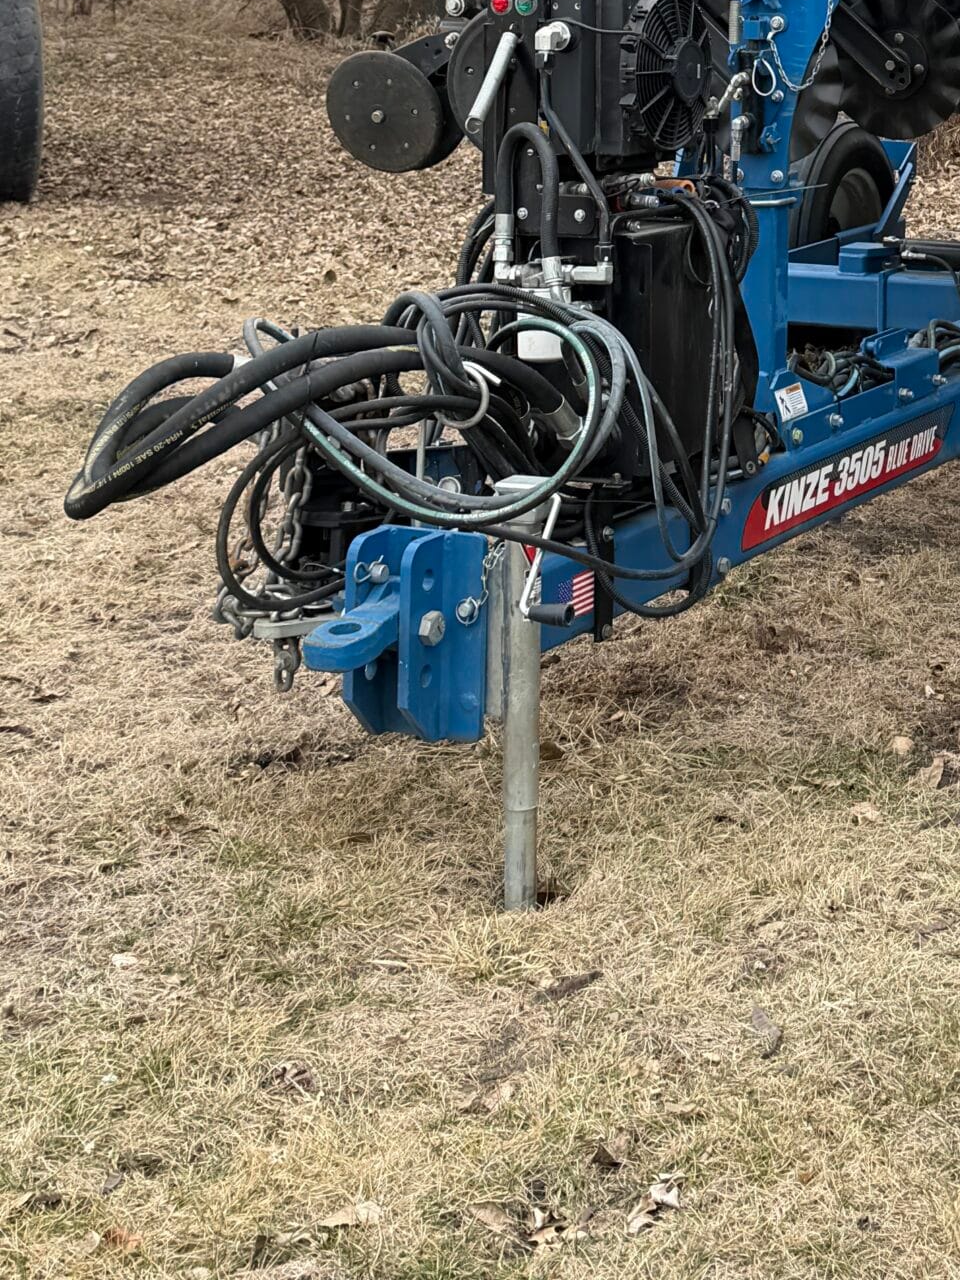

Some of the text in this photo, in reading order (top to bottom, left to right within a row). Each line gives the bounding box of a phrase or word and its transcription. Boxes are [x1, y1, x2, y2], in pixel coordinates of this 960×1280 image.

[134, 448, 154, 465] SAE
[764, 425, 938, 531] KINZE 3505 BLUE DRIVE
